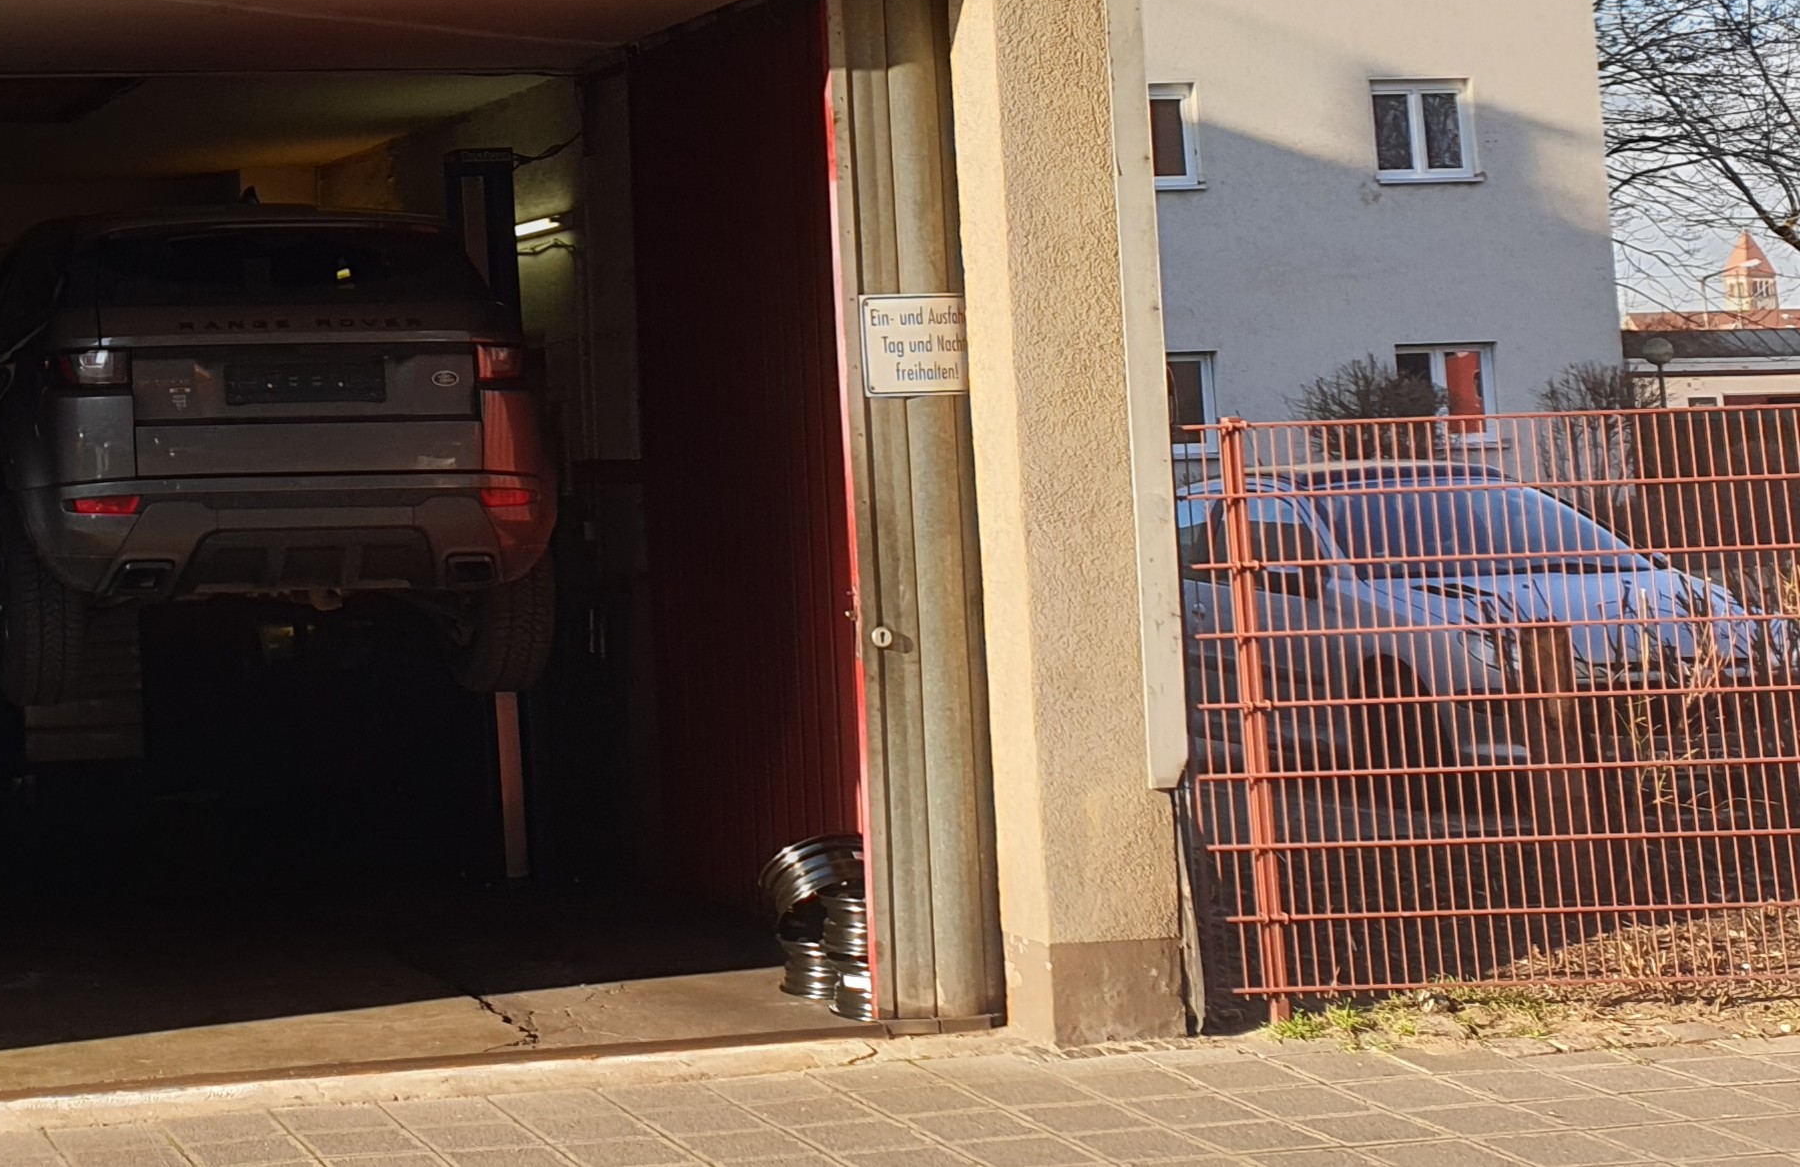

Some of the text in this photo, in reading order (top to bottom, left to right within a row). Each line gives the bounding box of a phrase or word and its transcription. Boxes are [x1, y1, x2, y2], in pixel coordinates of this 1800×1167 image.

[179, 317, 422, 331] RANGE ROVER
[870, 308, 895, 327] Ein-
[900, 306, 924, 325] und
[881, 335, 904, 357] Tag
[909, 334, 932, 353] und
[896, 361, 960, 381] freihalten!
